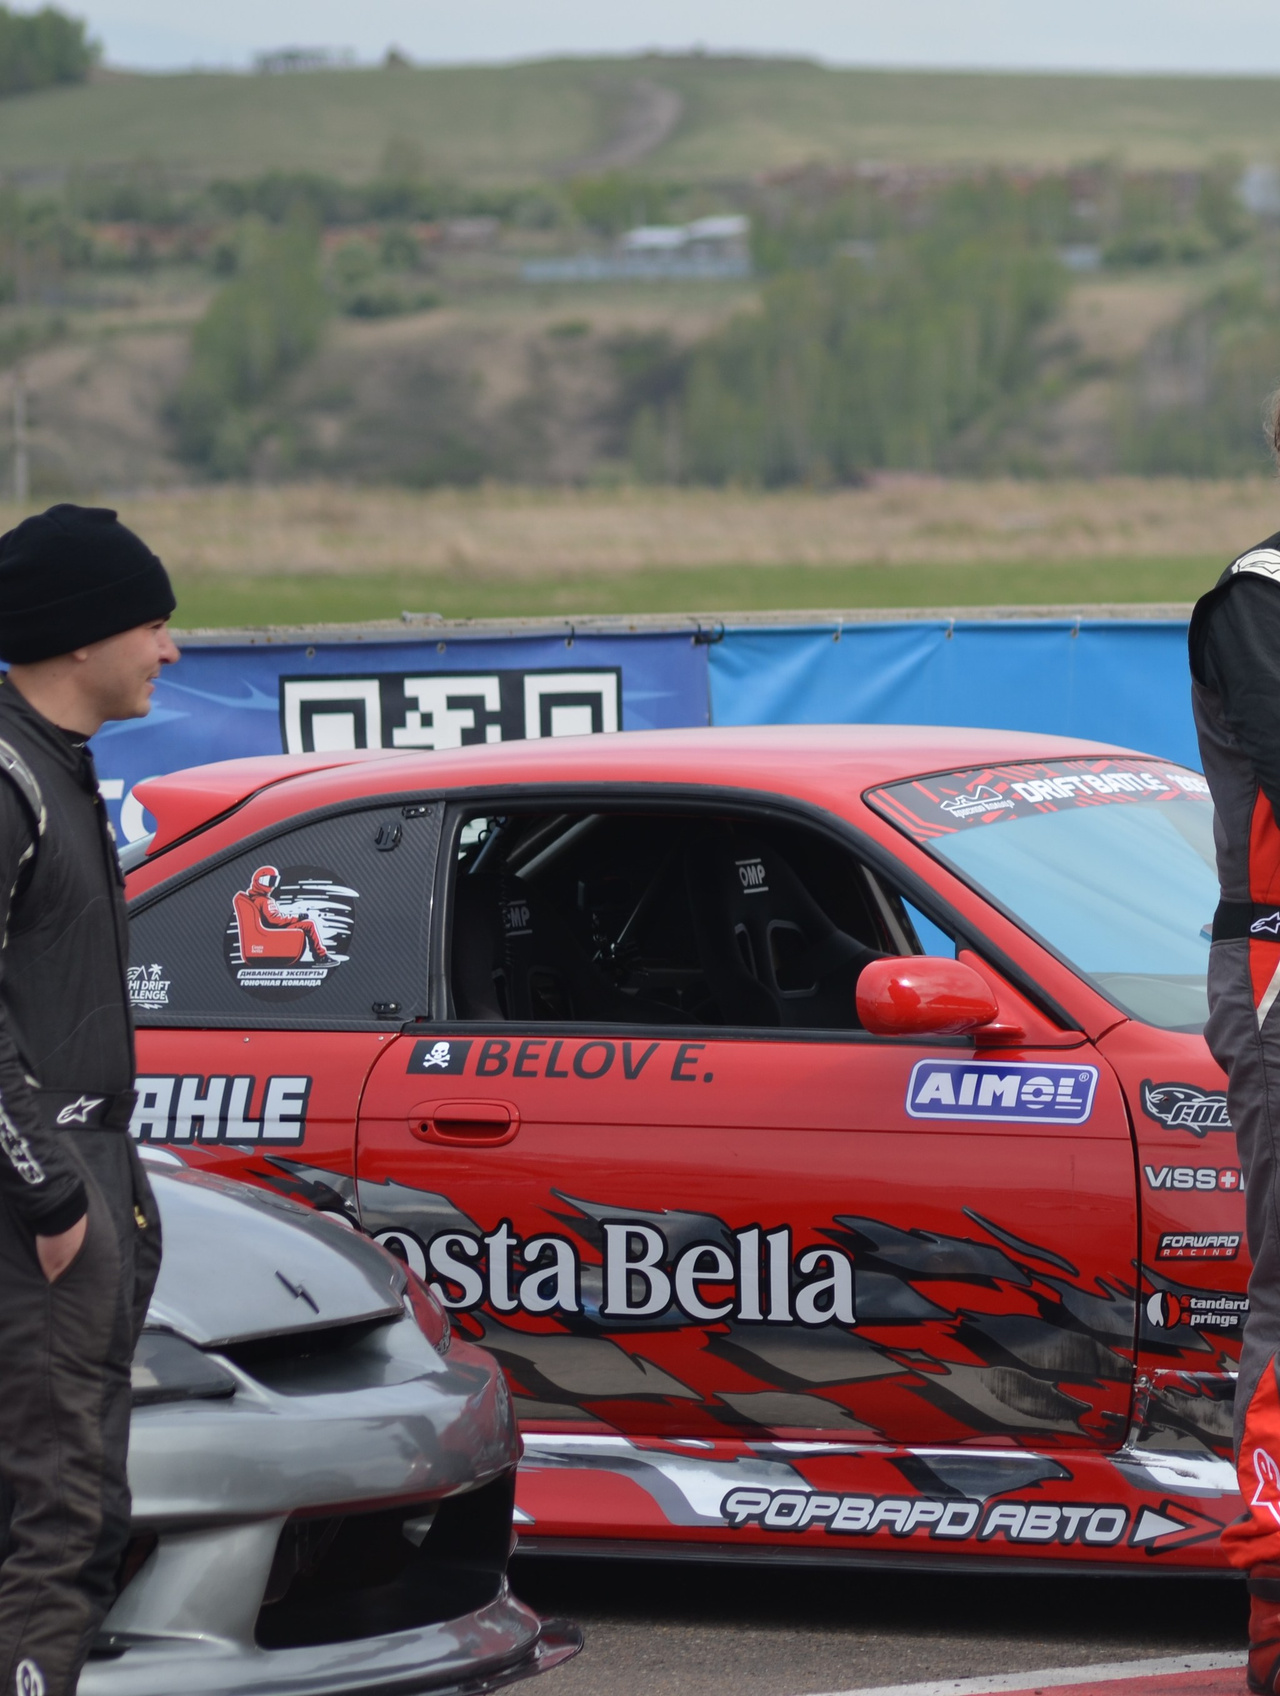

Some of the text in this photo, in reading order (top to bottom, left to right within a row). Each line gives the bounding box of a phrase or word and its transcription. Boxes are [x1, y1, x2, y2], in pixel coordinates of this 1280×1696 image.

[1010, 777, 1093, 803] DRIFT
[1091, 773, 1172, 795] BATTLE
[739, 864, 766, 887] OMP
[129, 990, 167, 1000] LLENGE
[141, 980, 171, 991] DRIFT
[474, 1038, 714, 1083] BELOV E.
[914, 1071, 1083, 1110] AIMOL
[127, 1076, 308, 1139] AHLE
[1161, 1235, 1240, 1248] FORWARD
[1163, 1248, 1233, 1257] RACING
[322, 1211, 856, 1325] osta Bella
[1180, 1295, 1250, 1311] Standard
[1180, 1312, 1239, 1328] Springs
[983, 1505, 1127, 1542] АВТО
